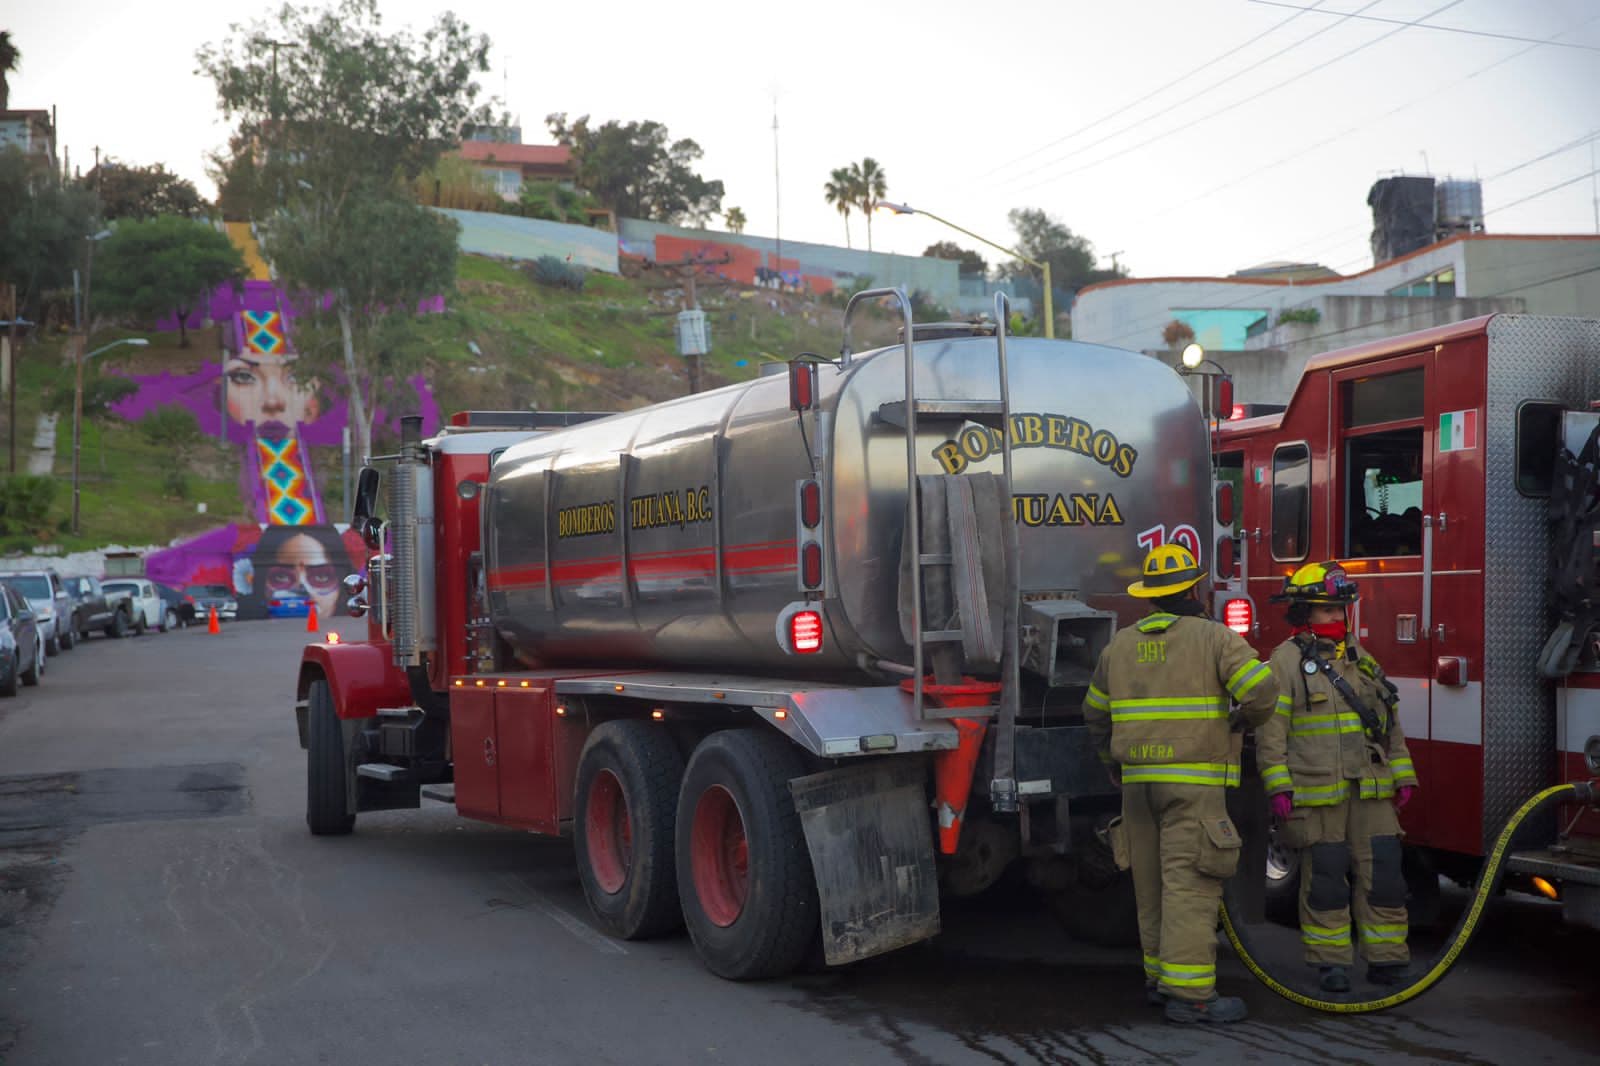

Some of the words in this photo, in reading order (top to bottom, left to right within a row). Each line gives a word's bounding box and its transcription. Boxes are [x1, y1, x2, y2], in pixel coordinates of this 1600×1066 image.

[932, 413, 1137, 478] BOMBEROS
[559, 502, 615, 538] BOMBEROS
[631, 490, 685, 531] TIJUANA,
[686, 485, 712, 523] B.C.
[1129, 744, 1175, 761] RIVERA
